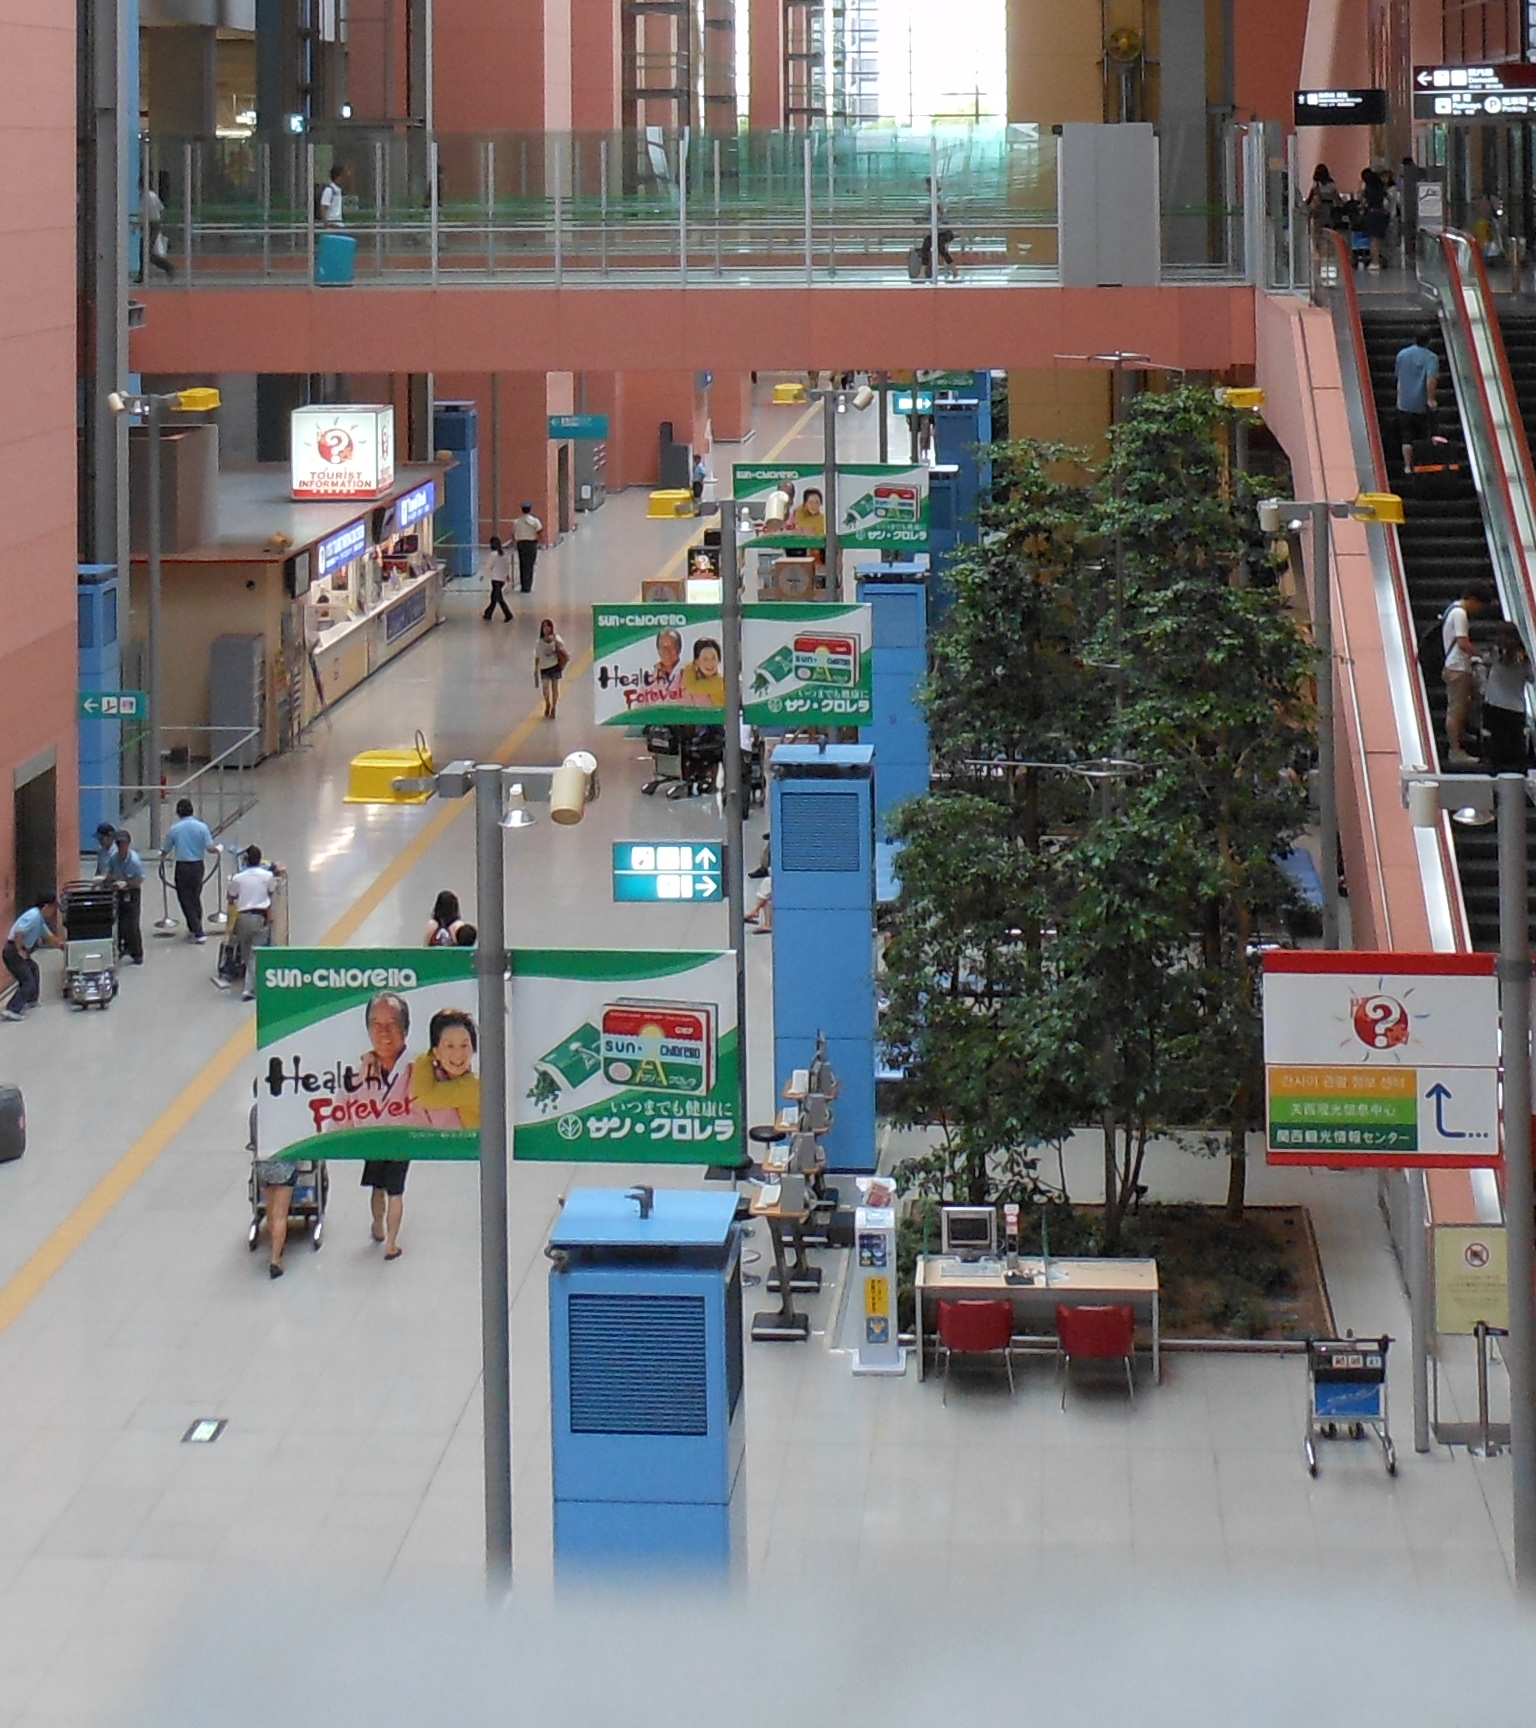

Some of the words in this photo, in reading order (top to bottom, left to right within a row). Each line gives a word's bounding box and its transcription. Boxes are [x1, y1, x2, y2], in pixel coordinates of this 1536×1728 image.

[299, 480, 372, 488] INFORMATION
[309, 471, 362, 480] TOURIST
[597, 665, 676, 690] Healthy
[623, 687, 686, 711] Forever
[265, 1055, 400, 1102] Healthy
[308, 1095, 420, 1133] Forever
